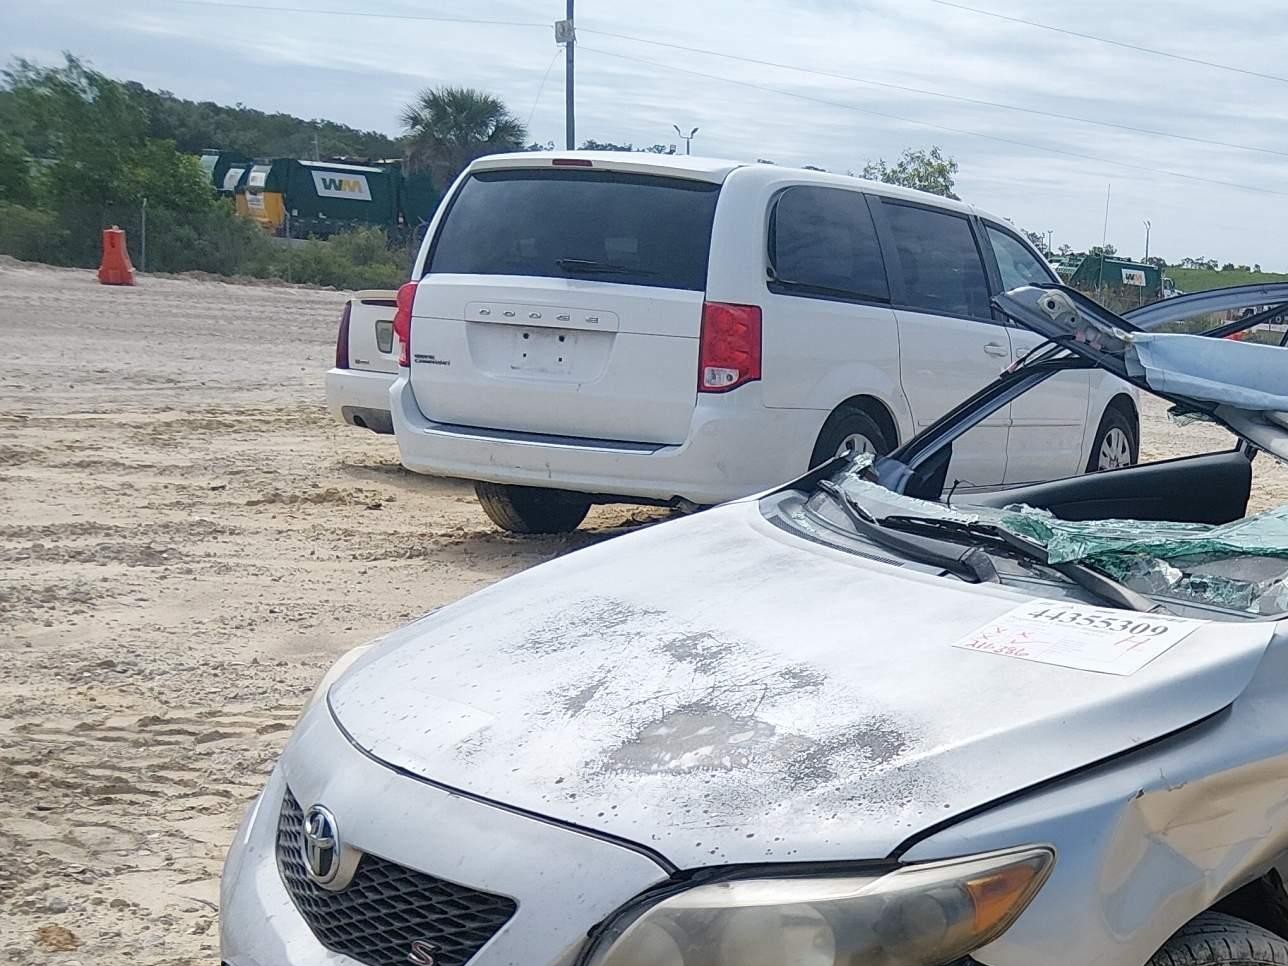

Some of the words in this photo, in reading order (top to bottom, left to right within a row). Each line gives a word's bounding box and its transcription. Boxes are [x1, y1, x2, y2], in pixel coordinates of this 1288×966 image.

[321, 177, 363, 193] WM
[479, 308, 599, 324] DODGE
[1027, 608, 1169, 637] 44355309
[408, 940, 435, 966] S
